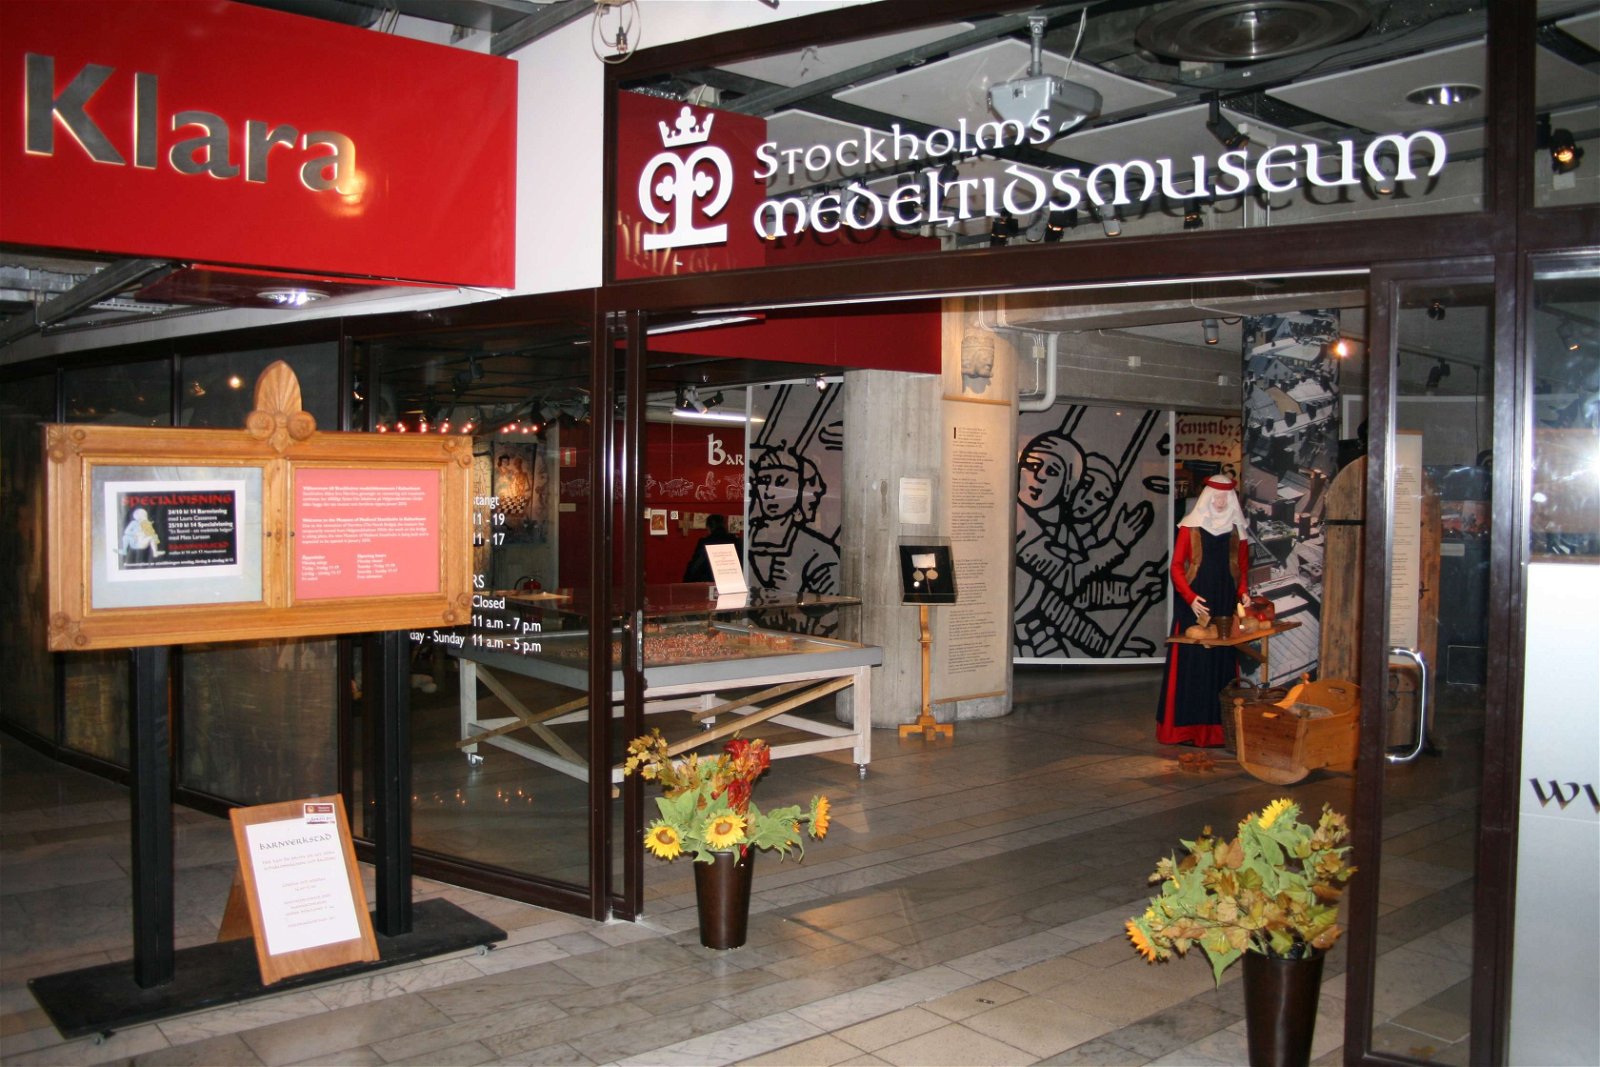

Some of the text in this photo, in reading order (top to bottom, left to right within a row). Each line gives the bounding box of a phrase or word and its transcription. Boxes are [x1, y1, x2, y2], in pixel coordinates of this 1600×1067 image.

[24, 51, 360, 196] Klara
[753, 115, 1052, 180] Stockholms
[473, 494, 500, 510] tängt
[493, 512, 506, 526] 19
[493, 532, 506, 546] 17
[472, 595, 505, 609] Closed
[472, 614, 483, 627] 11
[486, 619, 504, 629] a.m
[513, 617, 520, 630] 7
[523, 621, 541, 634] p.m
[433, 630, 465, 648] Sunday
[472, 633, 483, 647] 11
[486, 638, 504, 649] a.m
[513, 636, 520, 650] 5
[523, 641, 541, 655] p.m
